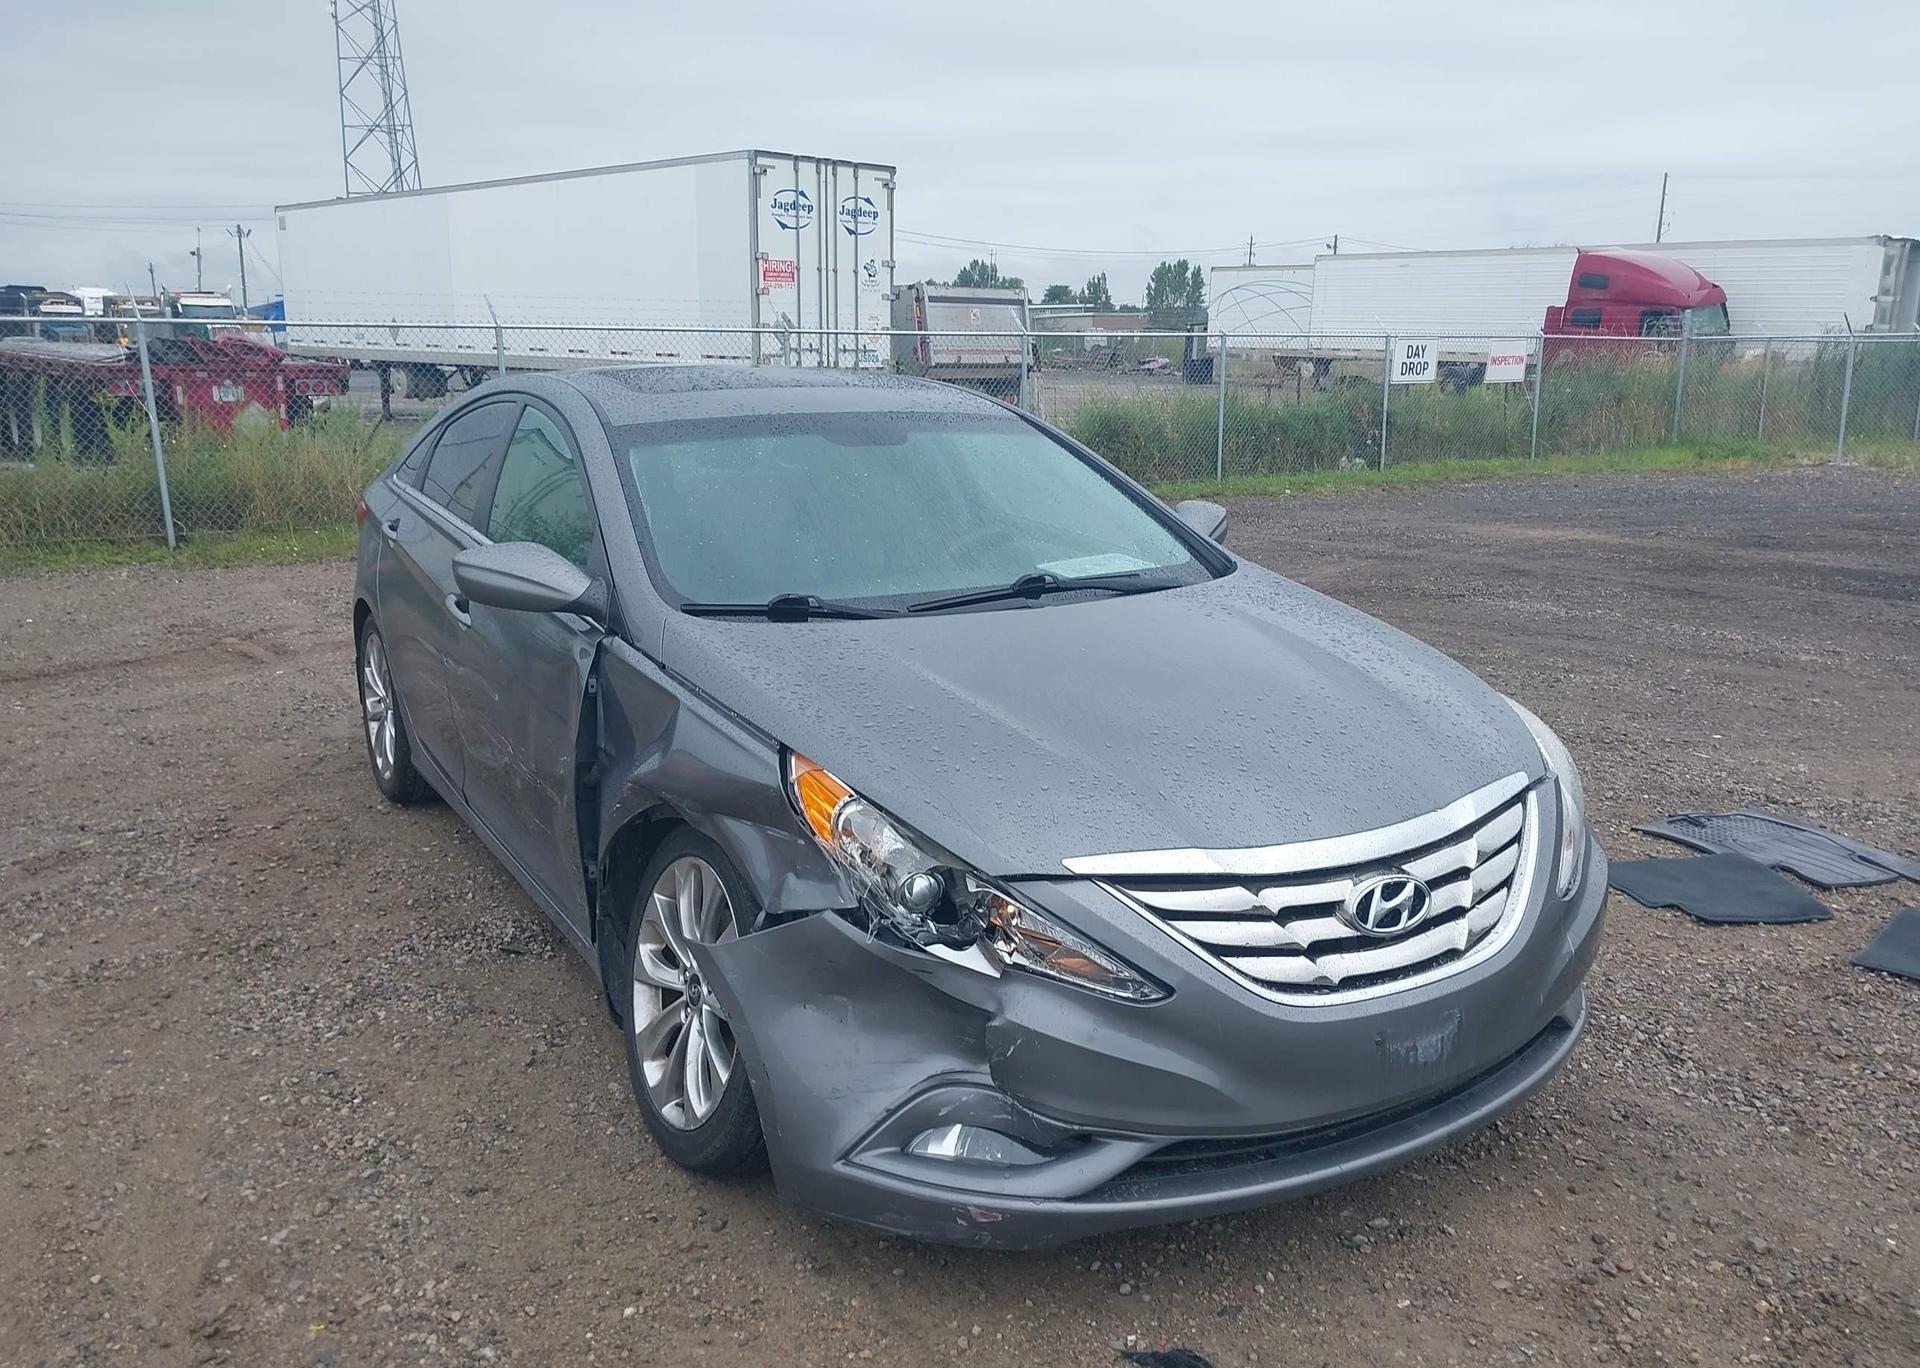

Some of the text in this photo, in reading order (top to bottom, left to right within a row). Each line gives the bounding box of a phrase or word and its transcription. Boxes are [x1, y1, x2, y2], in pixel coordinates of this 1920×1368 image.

[839, 205, 879, 221] Jagdeep
[763, 260, 794, 272] HIRING!
[1406, 344, 1427, 359] DAY
[1490, 354, 1525, 366] INSPECTION
[1400, 361, 1429, 376] DROP
